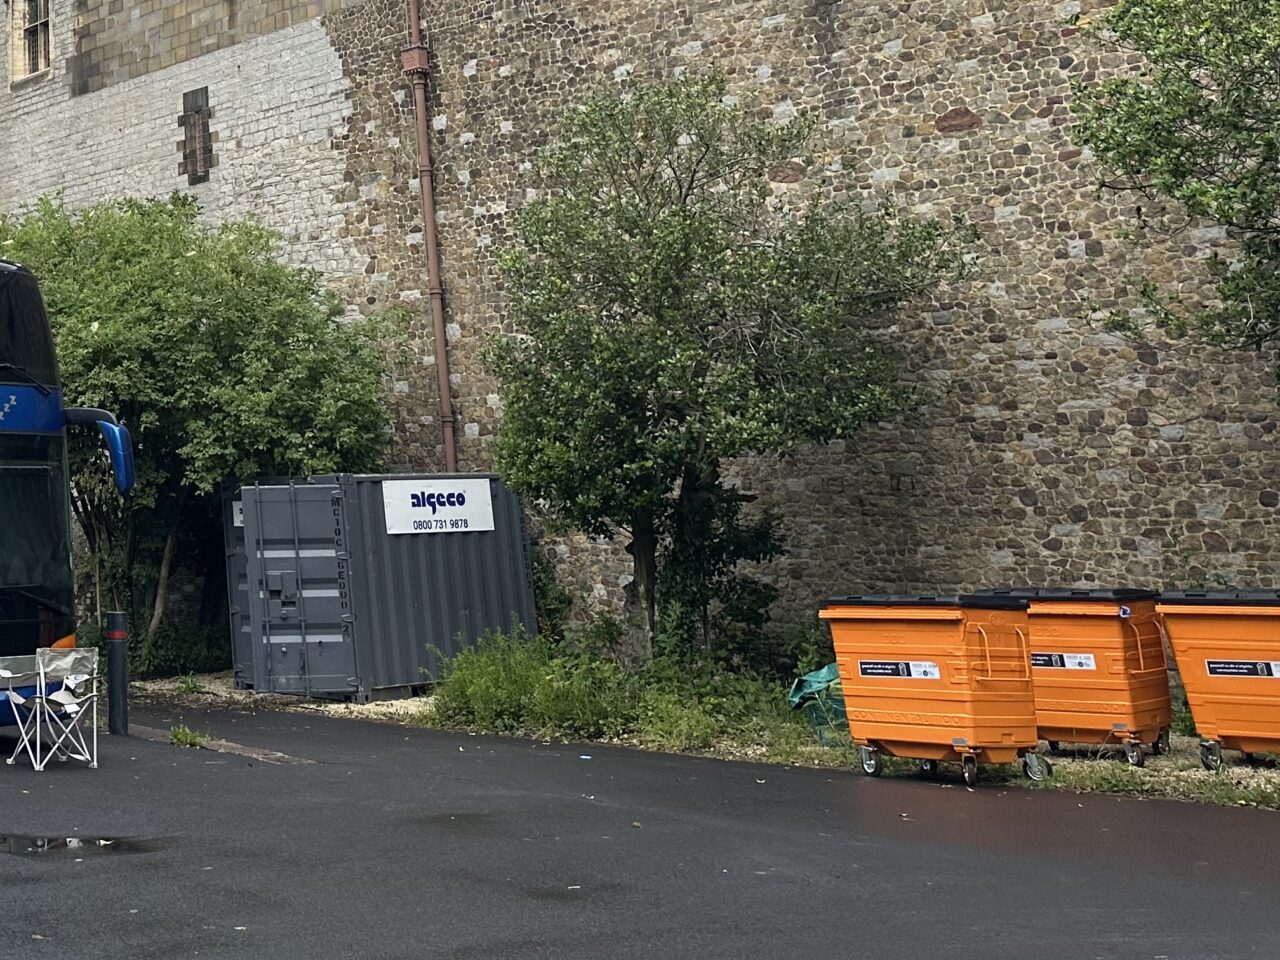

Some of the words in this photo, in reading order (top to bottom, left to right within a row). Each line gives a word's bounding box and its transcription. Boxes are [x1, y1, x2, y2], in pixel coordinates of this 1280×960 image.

[413, 520, 432, 530] 0800
[434, 519, 447, 530] 731
[450, 518, 468, 529] 9878
